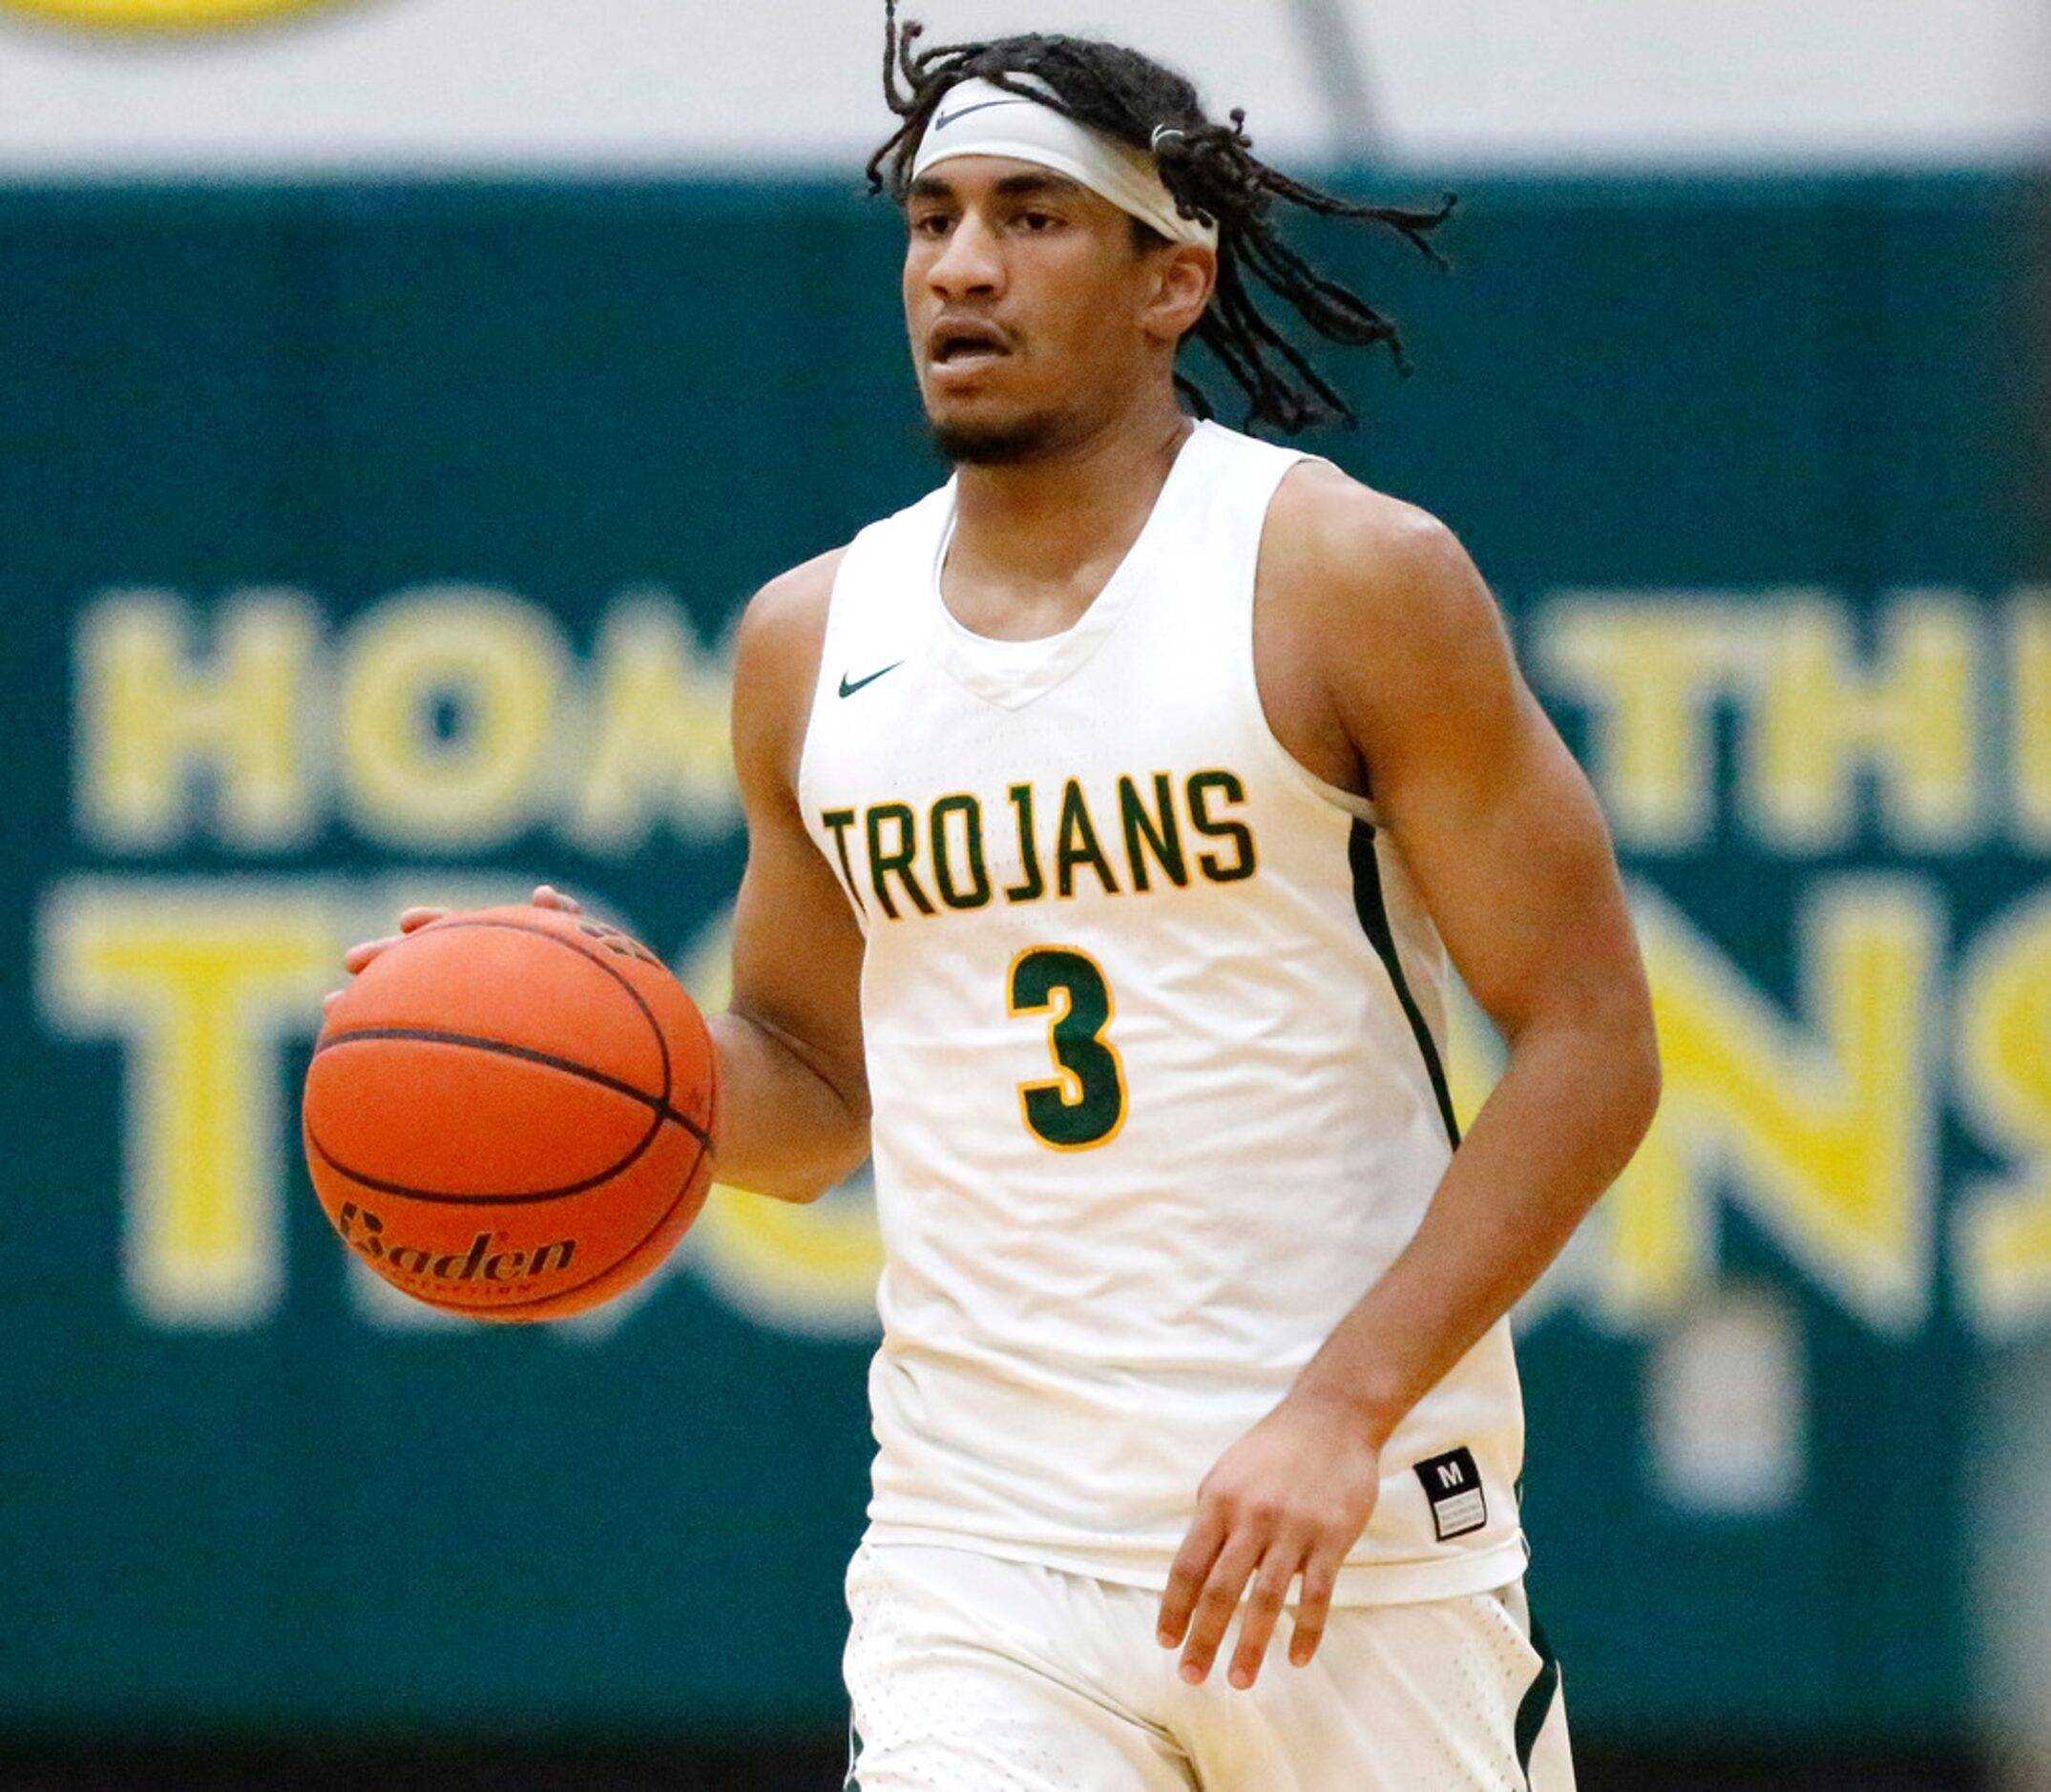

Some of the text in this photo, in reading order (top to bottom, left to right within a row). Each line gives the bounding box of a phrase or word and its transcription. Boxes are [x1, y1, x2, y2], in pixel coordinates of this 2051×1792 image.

[71, 586, 746, 853] HOM
[820, 767, 1258, 921] TROJANS
[1006, 944, 1130, 1153] 3
[339, 1200, 576, 1281] Baden
[1436, 1461, 1464, 1489] M
